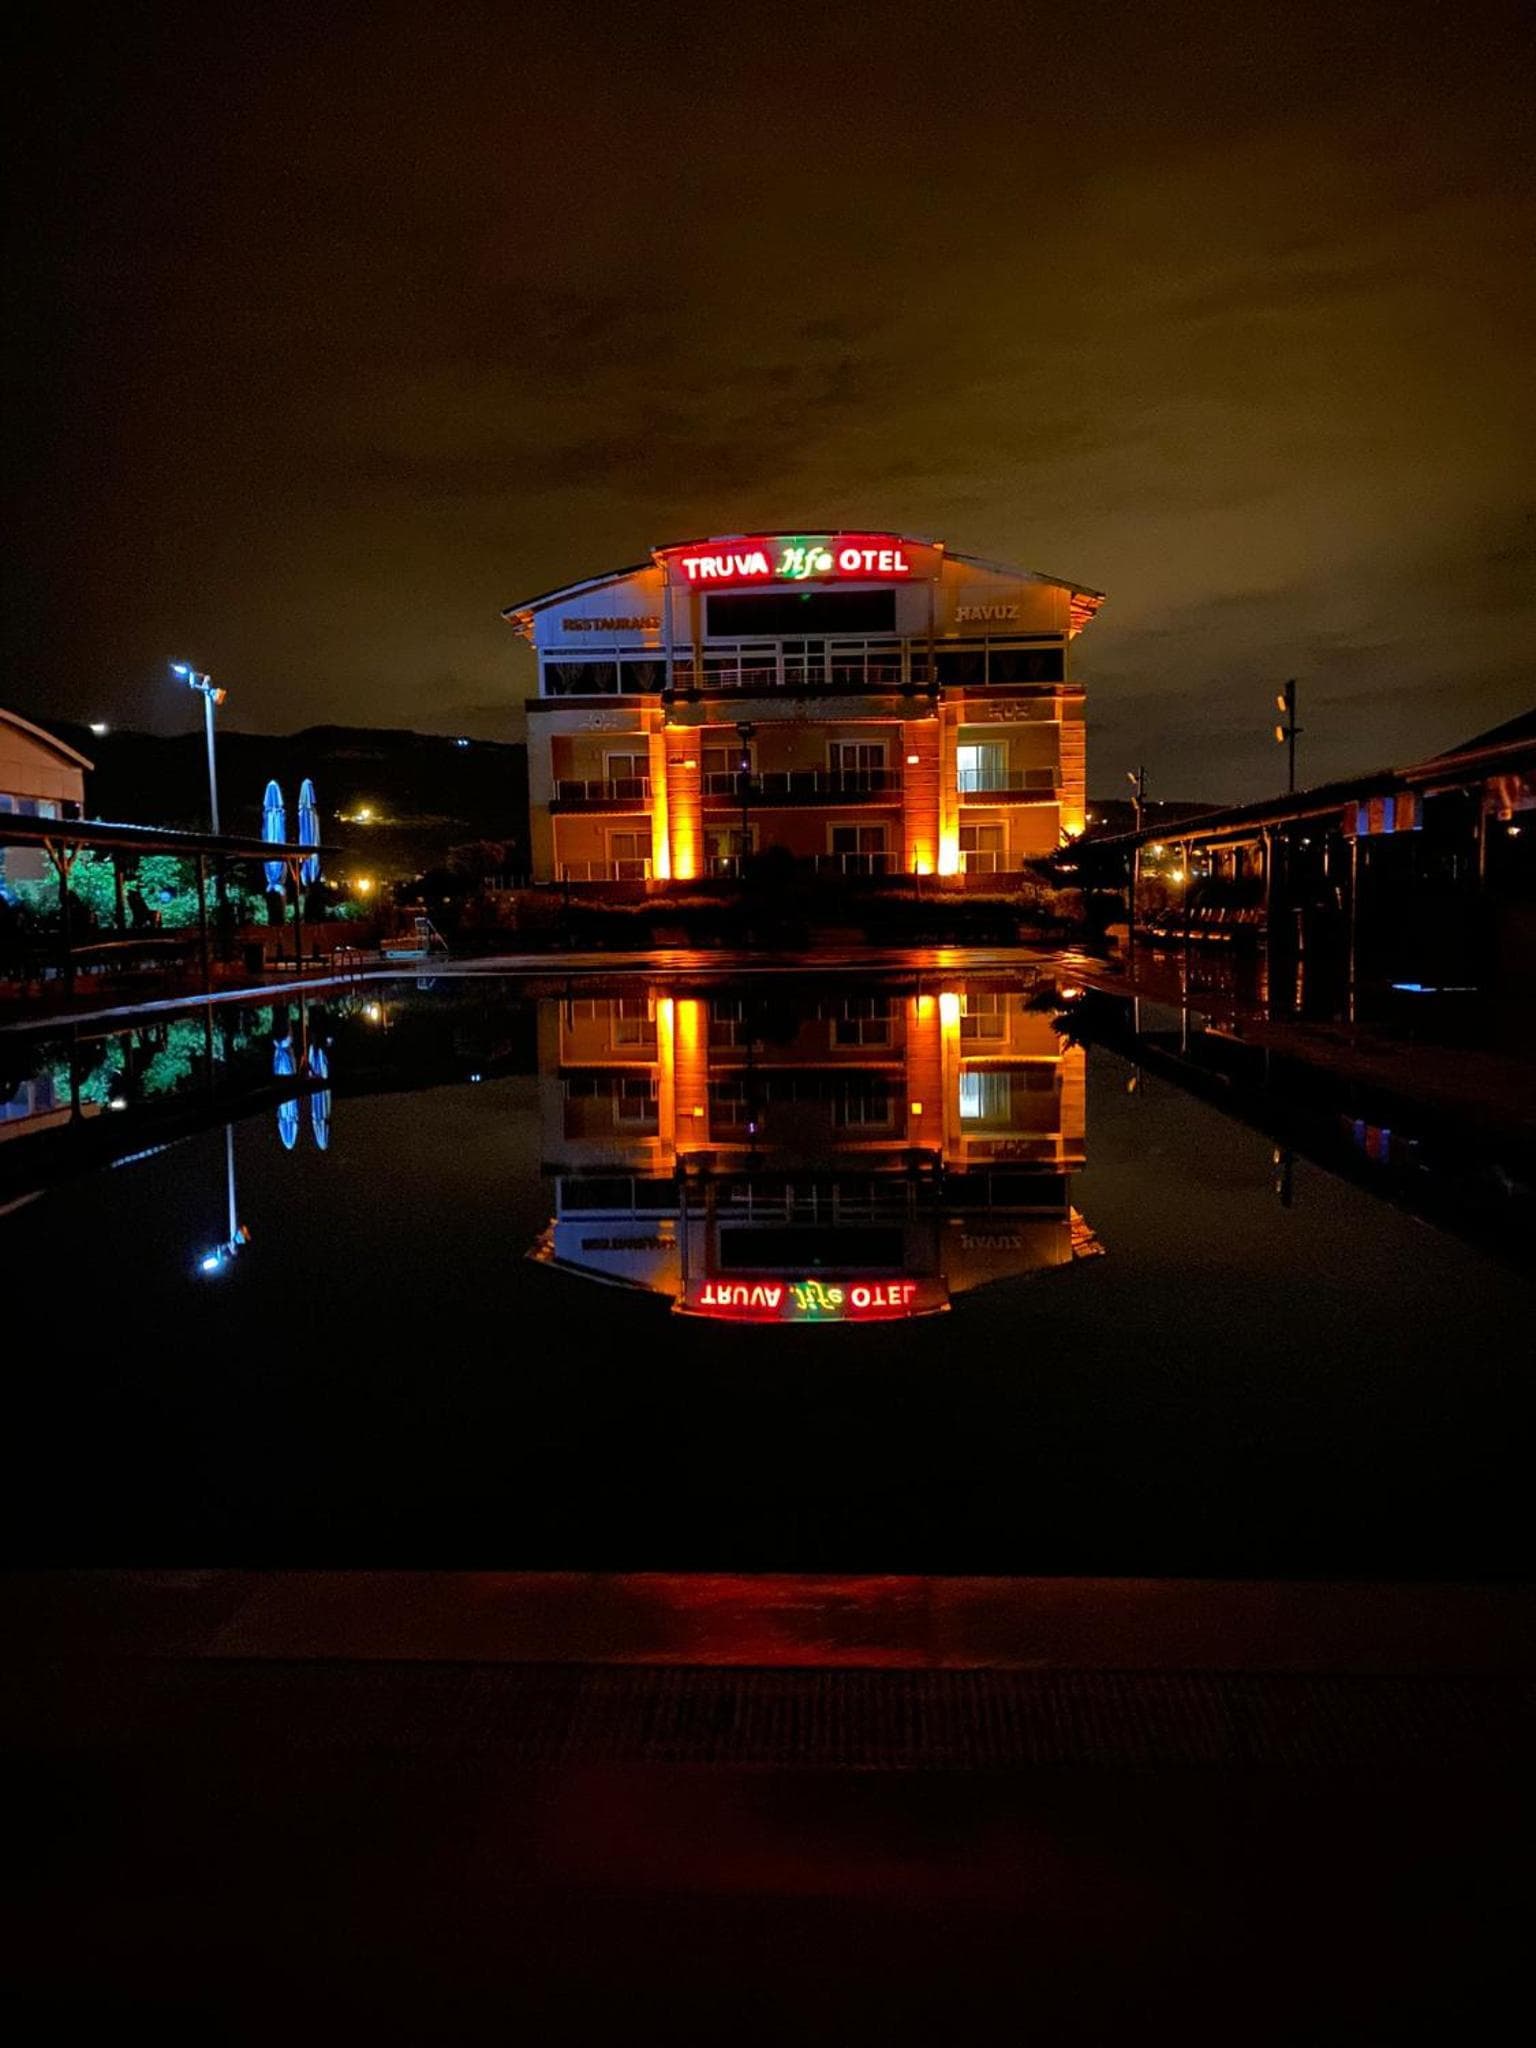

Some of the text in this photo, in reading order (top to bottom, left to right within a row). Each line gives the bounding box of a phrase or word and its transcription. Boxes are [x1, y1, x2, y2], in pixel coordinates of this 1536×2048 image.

[683, 552, 768, 579] TRUVA
[840, 549, 908, 571] OTEL
[955, 605, 1021, 622] HAVUZ
